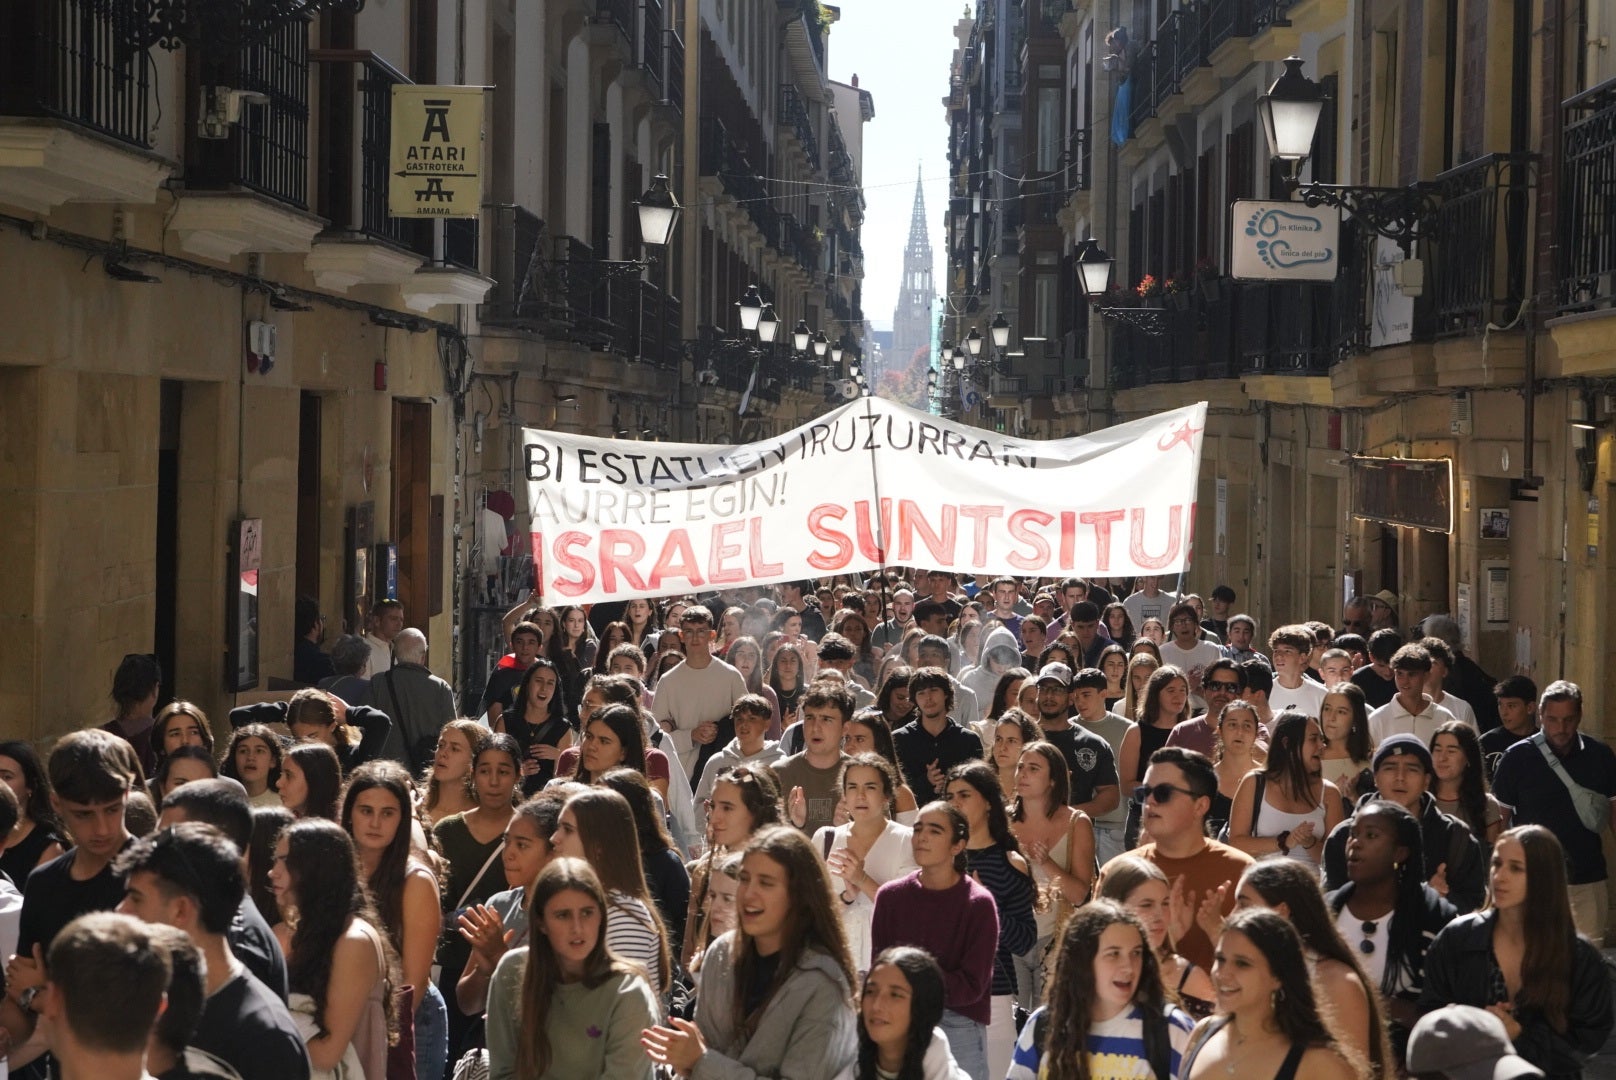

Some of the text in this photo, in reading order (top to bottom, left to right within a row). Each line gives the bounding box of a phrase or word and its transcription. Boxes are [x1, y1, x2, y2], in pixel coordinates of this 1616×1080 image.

[406, 146, 466, 161] ATARI
[406, 163, 464, 171] GASTROTEKA
[417, 207, 450, 215] AMAMA
[1302, 249, 1312, 257] del
[525, 443, 563, 482] BI
[529, 471, 787, 526] AURRE EGIN!
[530, 516, 784, 598] ISRAEL
